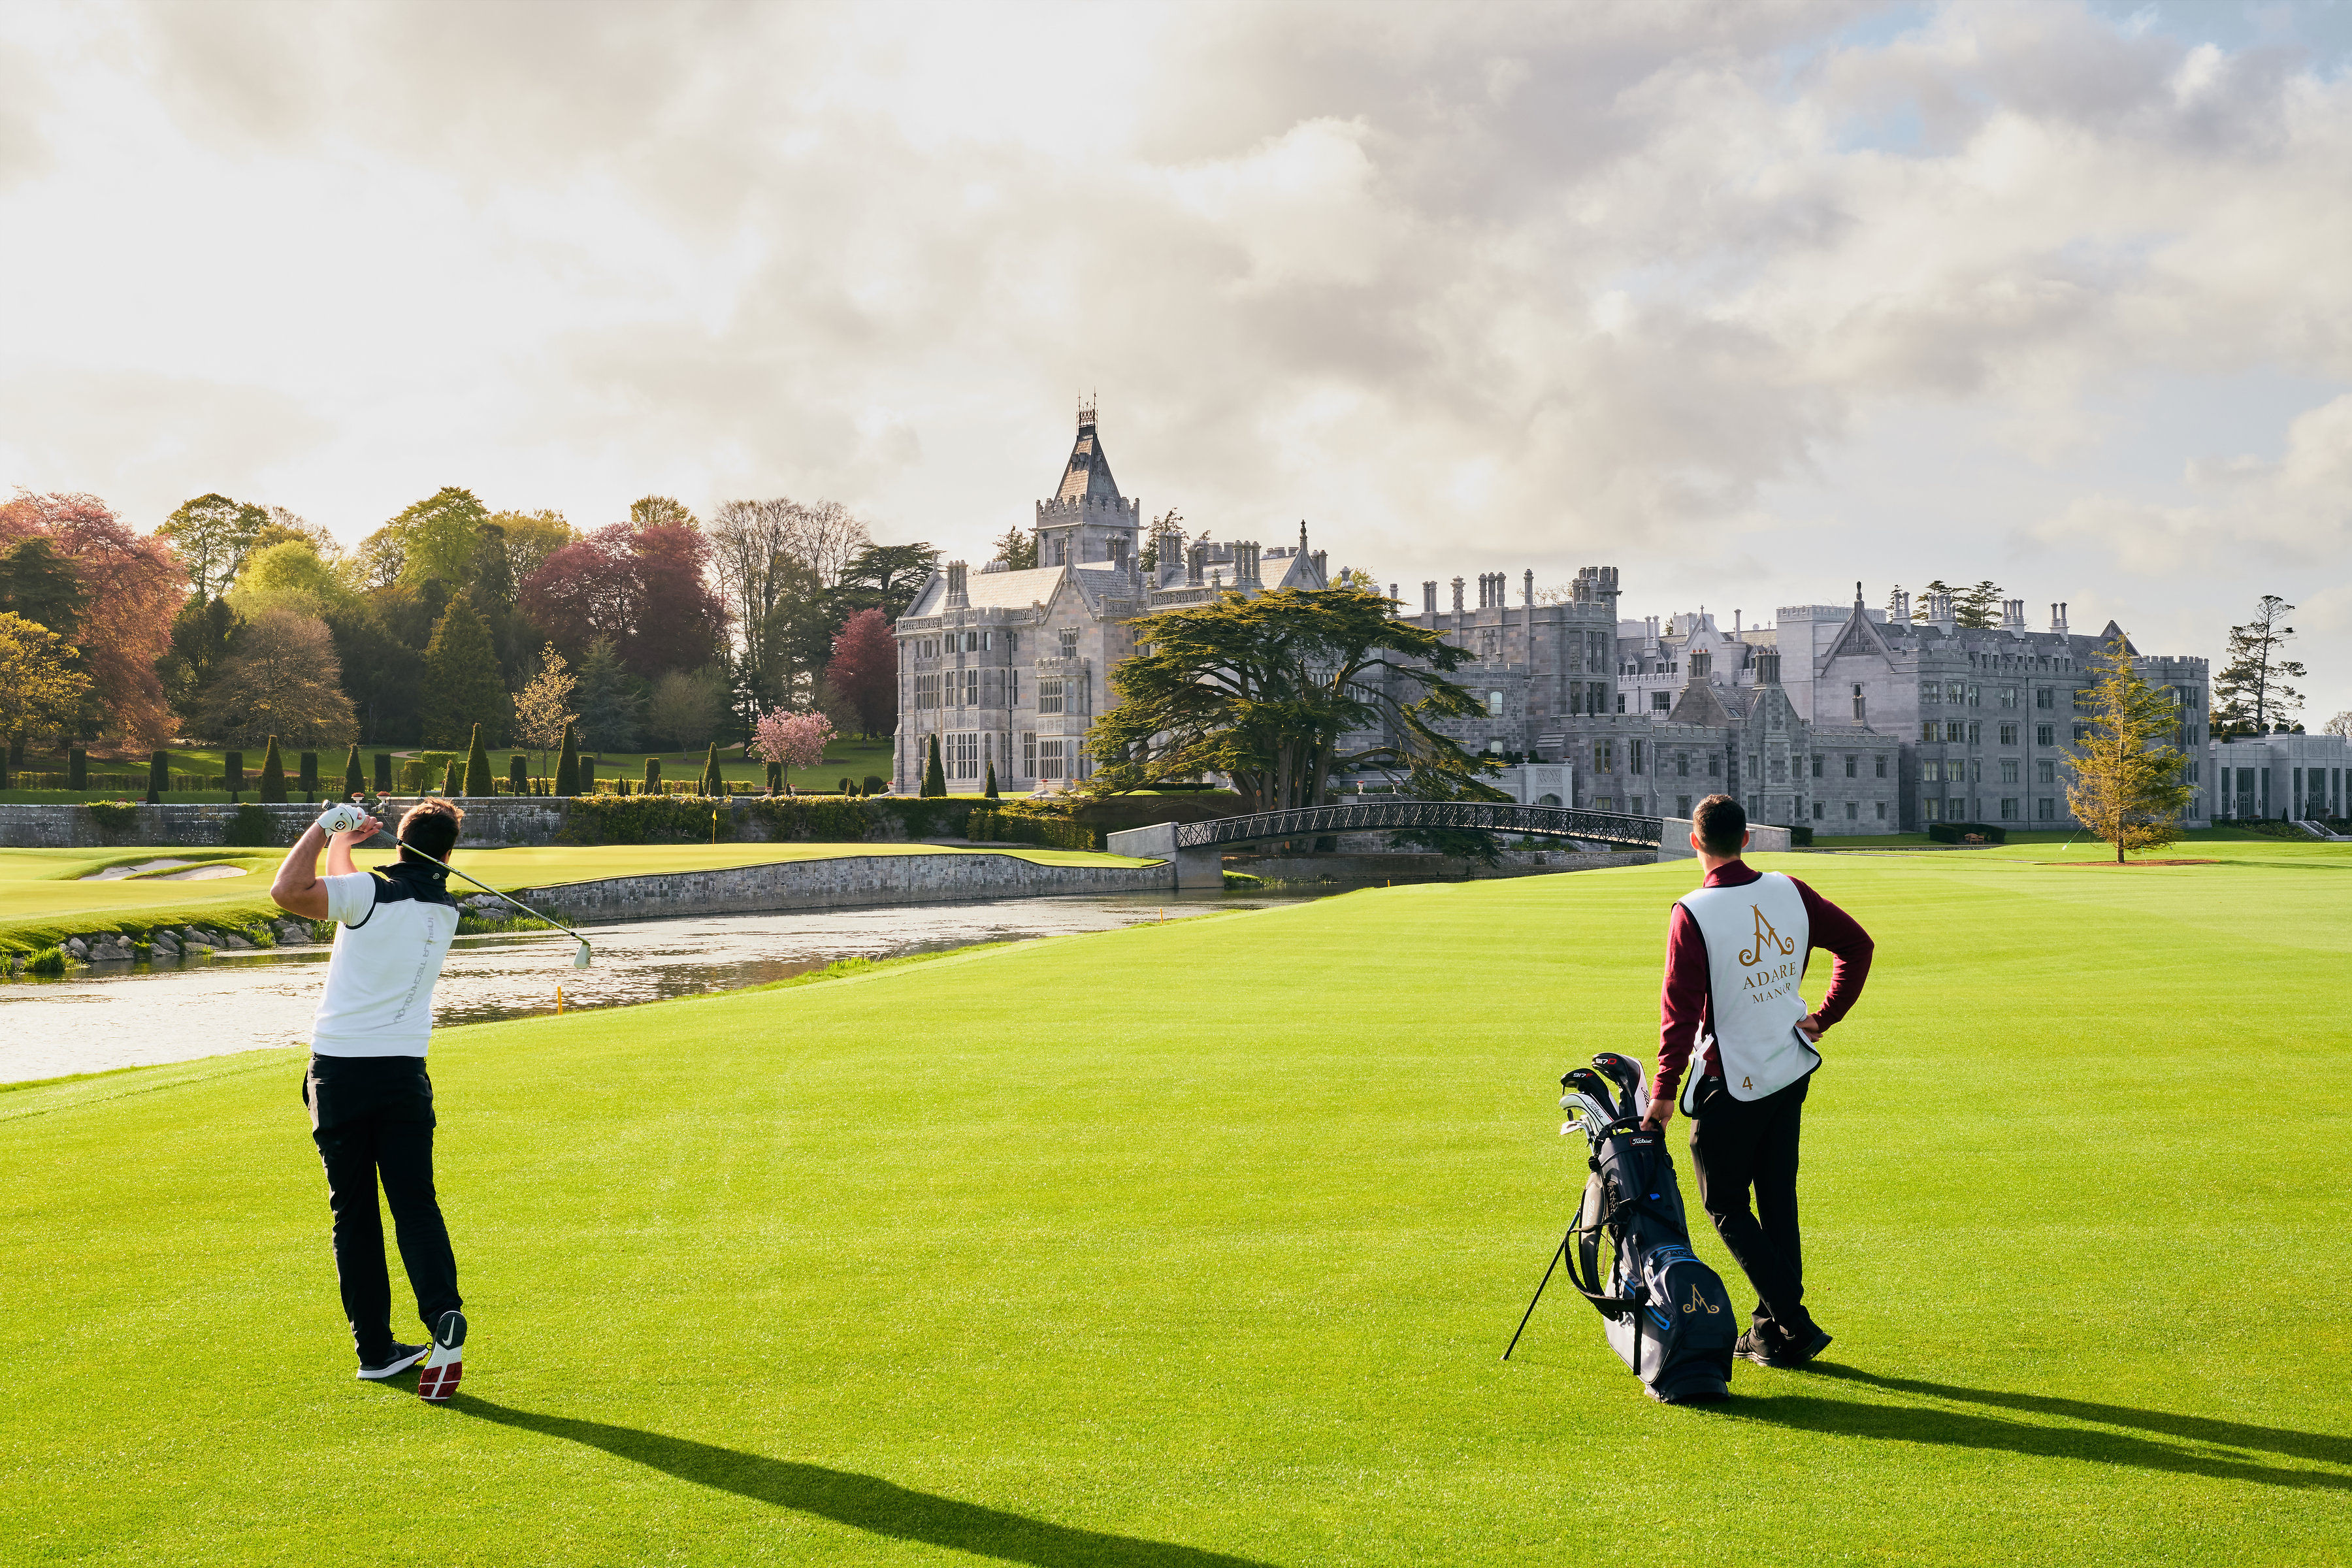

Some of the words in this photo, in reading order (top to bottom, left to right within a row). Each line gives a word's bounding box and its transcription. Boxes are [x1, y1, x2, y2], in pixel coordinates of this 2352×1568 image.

[1742, 962, 1796, 990] ADARE
[1752, 982, 1791, 1004] MANOR
[1742, 1076, 1753, 1090] 4
[1587, 1102, 1603, 1119] Titleist
